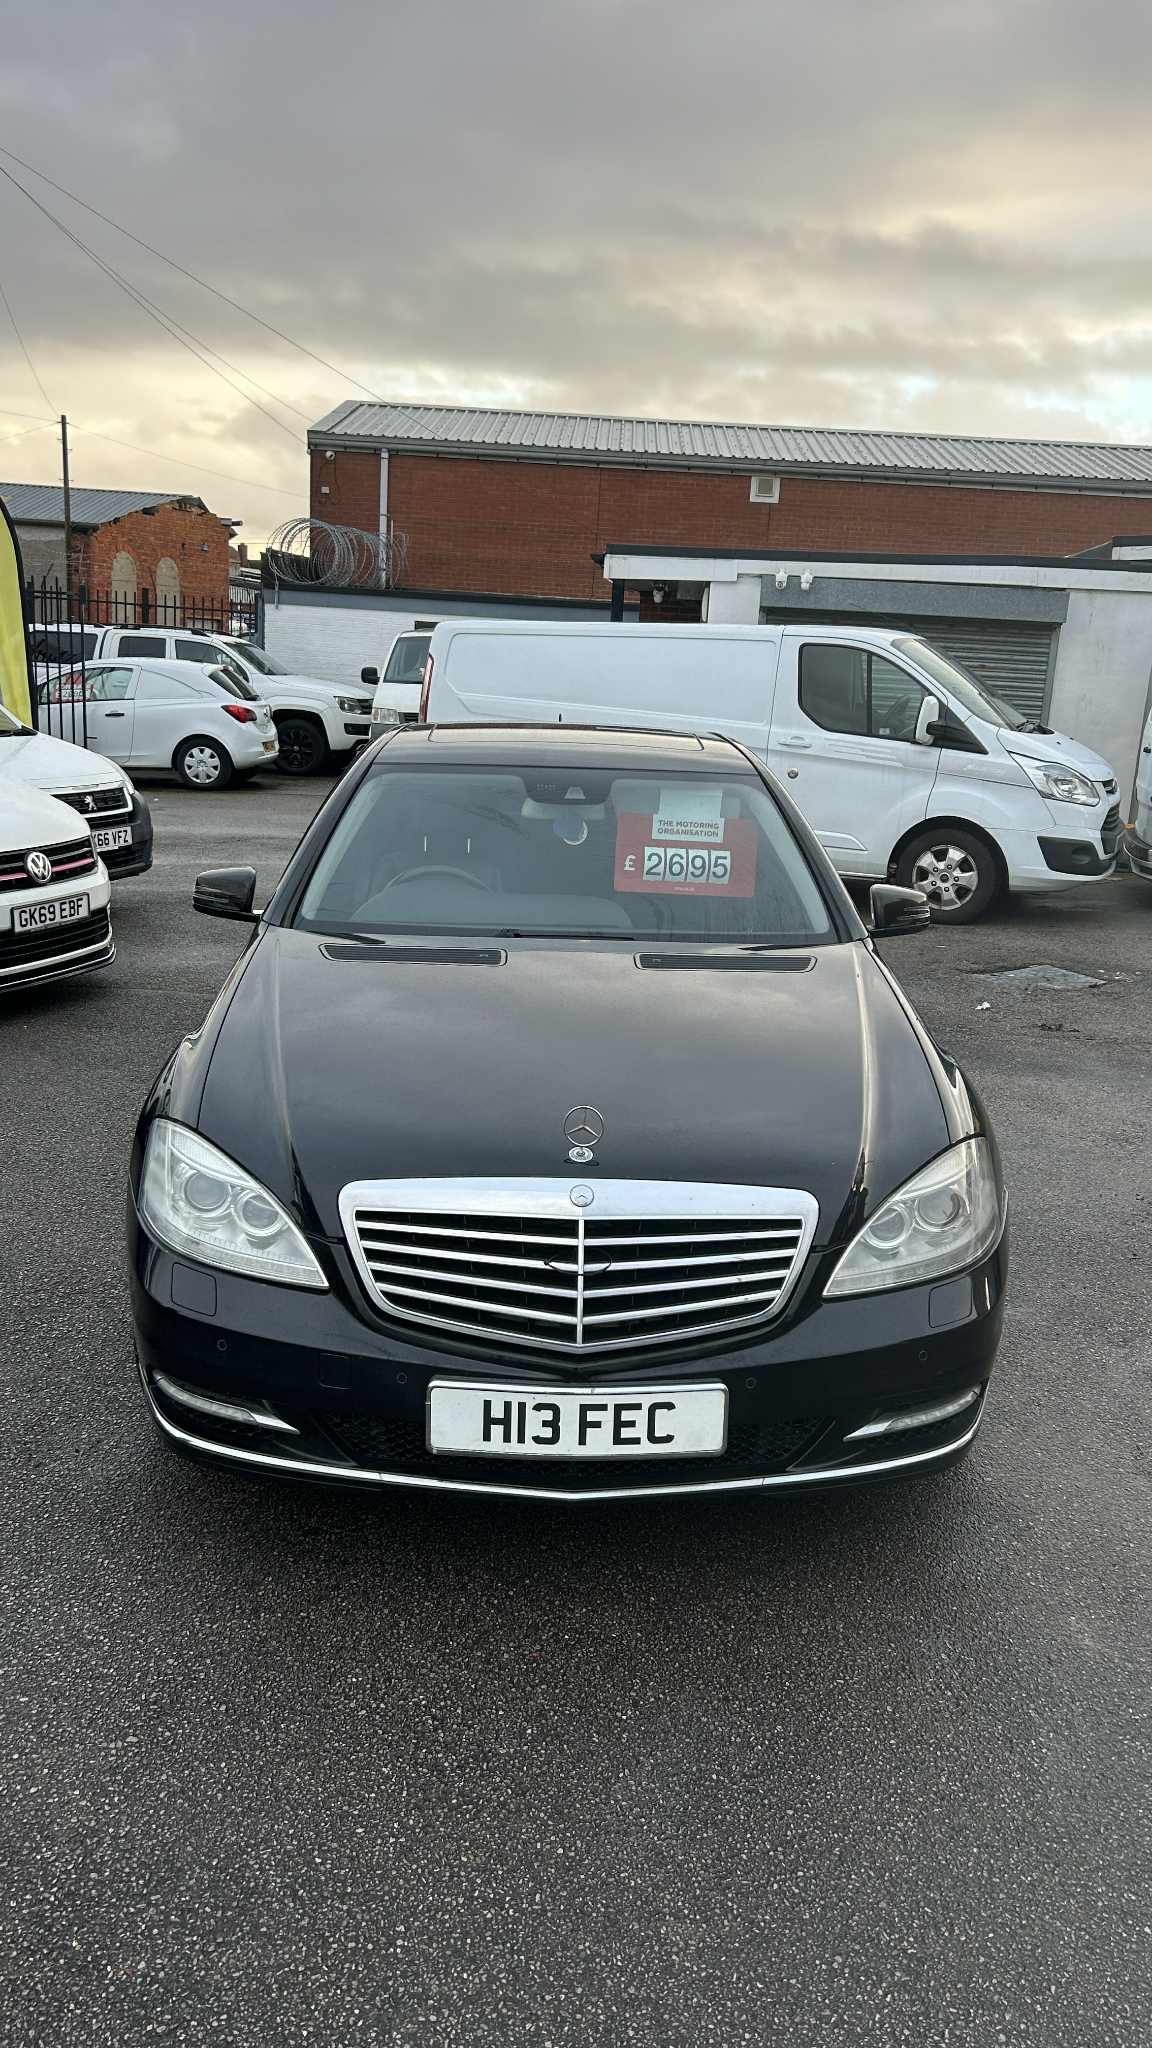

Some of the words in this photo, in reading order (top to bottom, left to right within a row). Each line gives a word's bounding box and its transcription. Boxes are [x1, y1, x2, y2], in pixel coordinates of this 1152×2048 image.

[657, 828, 719, 838] ORGANISATION
[659, 820, 674, 828] THE
[676, 820, 720, 830] MOTORING
[111, 829, 129, 845] VFZ
[645, 852, 728, 879] 2695
[19, 903, 57, 928] GK69
[59, 897, 84, 920] EBF
[482, 1399, 561, 1446] H13
[578, 1401, 676, 1446] FEC
